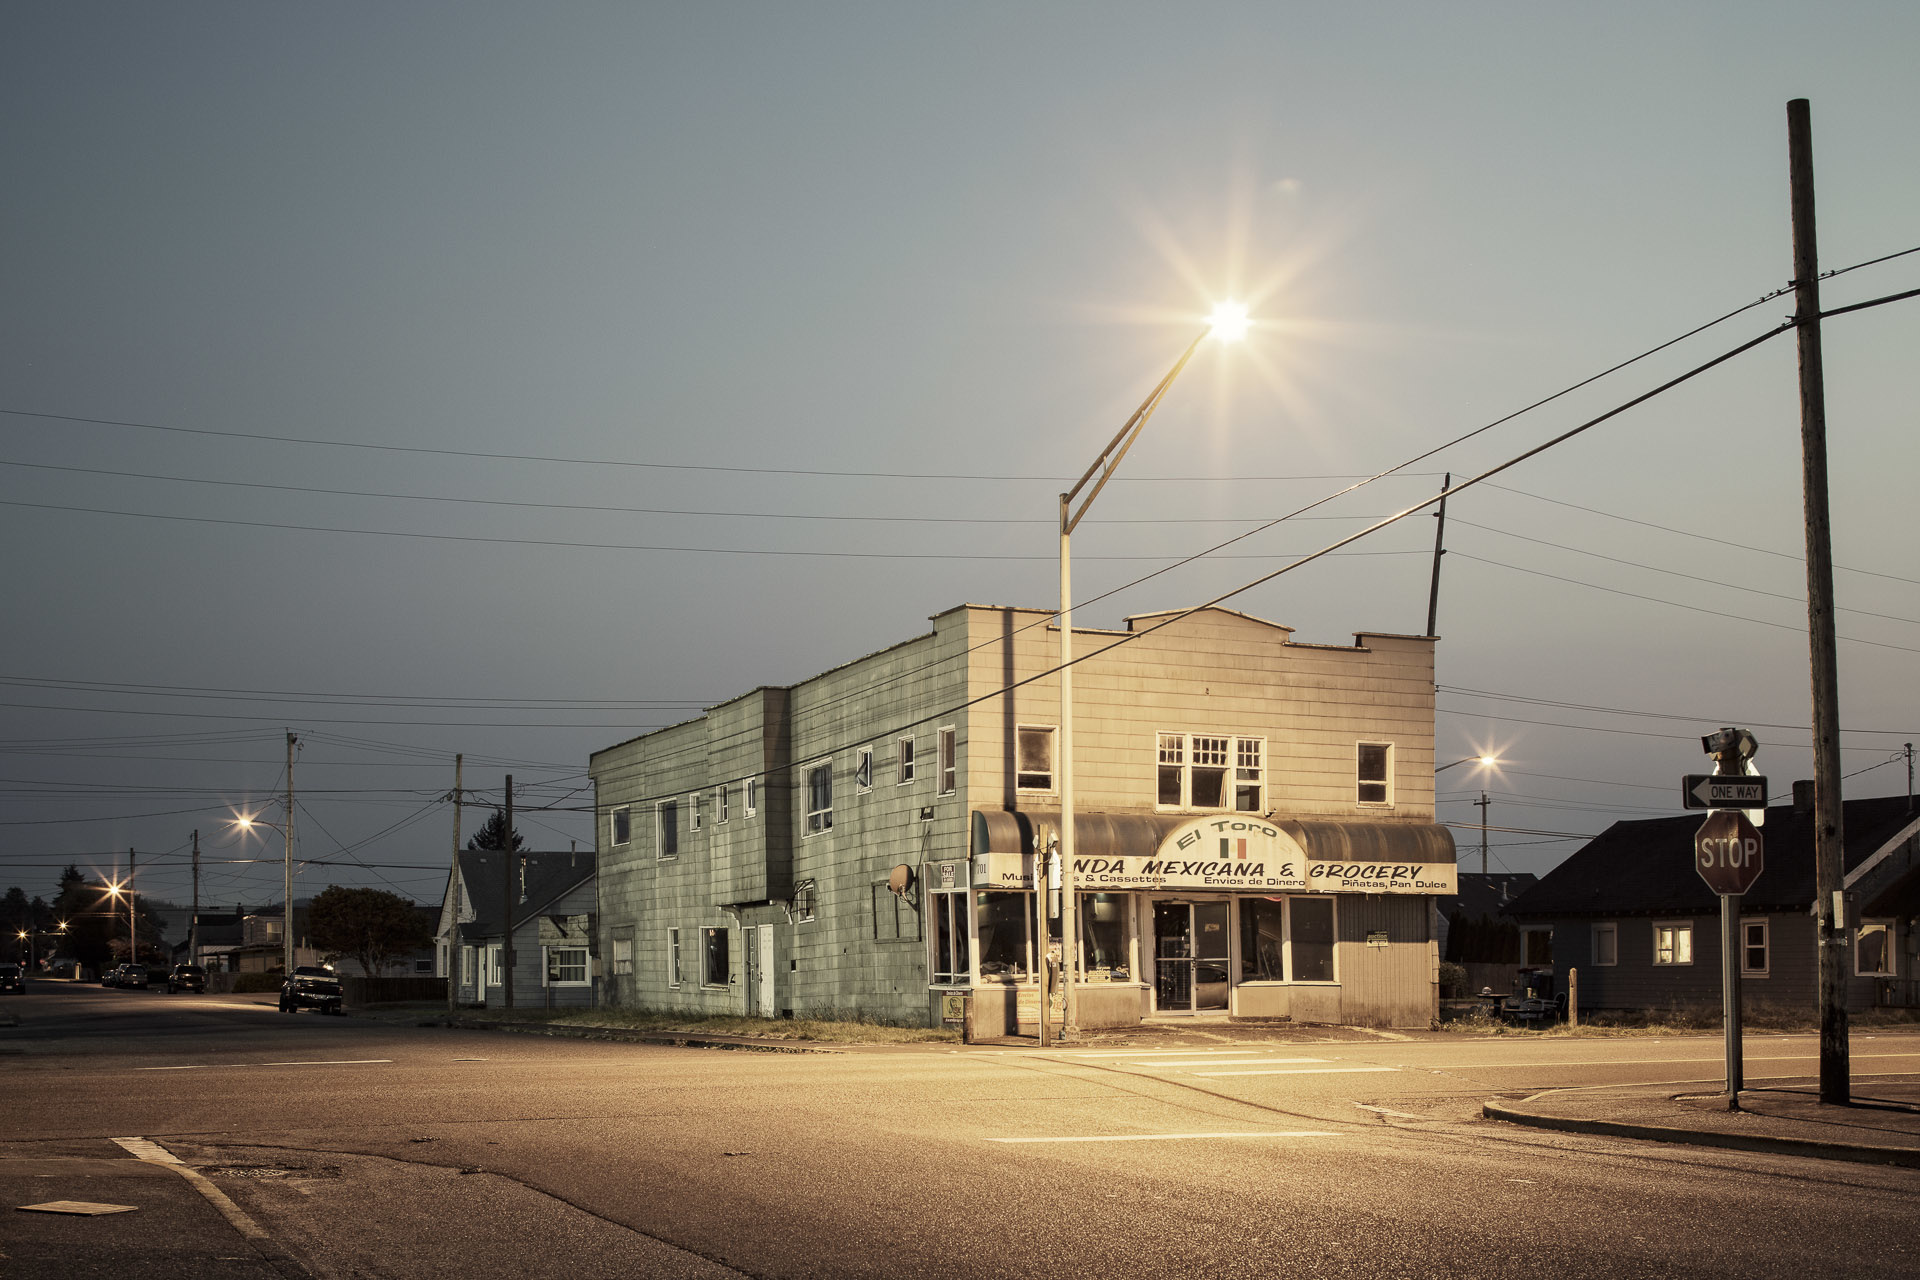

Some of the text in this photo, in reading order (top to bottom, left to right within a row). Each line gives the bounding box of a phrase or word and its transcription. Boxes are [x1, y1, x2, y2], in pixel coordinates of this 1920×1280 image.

[1711, 786, 1759, 798] ONE WAY
[1176, 820, 1278, 851] El Toro
[1701, 837, 1758, 868] STOP
[1141, 860, 1265, 876] MEXICANA
[1280, 862, 1295, 877] &
[1310, 864, 1423, 879] GROCERY
[1100, 874, 1167, 883] Cassettes
[1204, 876, 1306, 886] Envios de Dinero
[1342, 879, 1388, 889] Piñatas,
